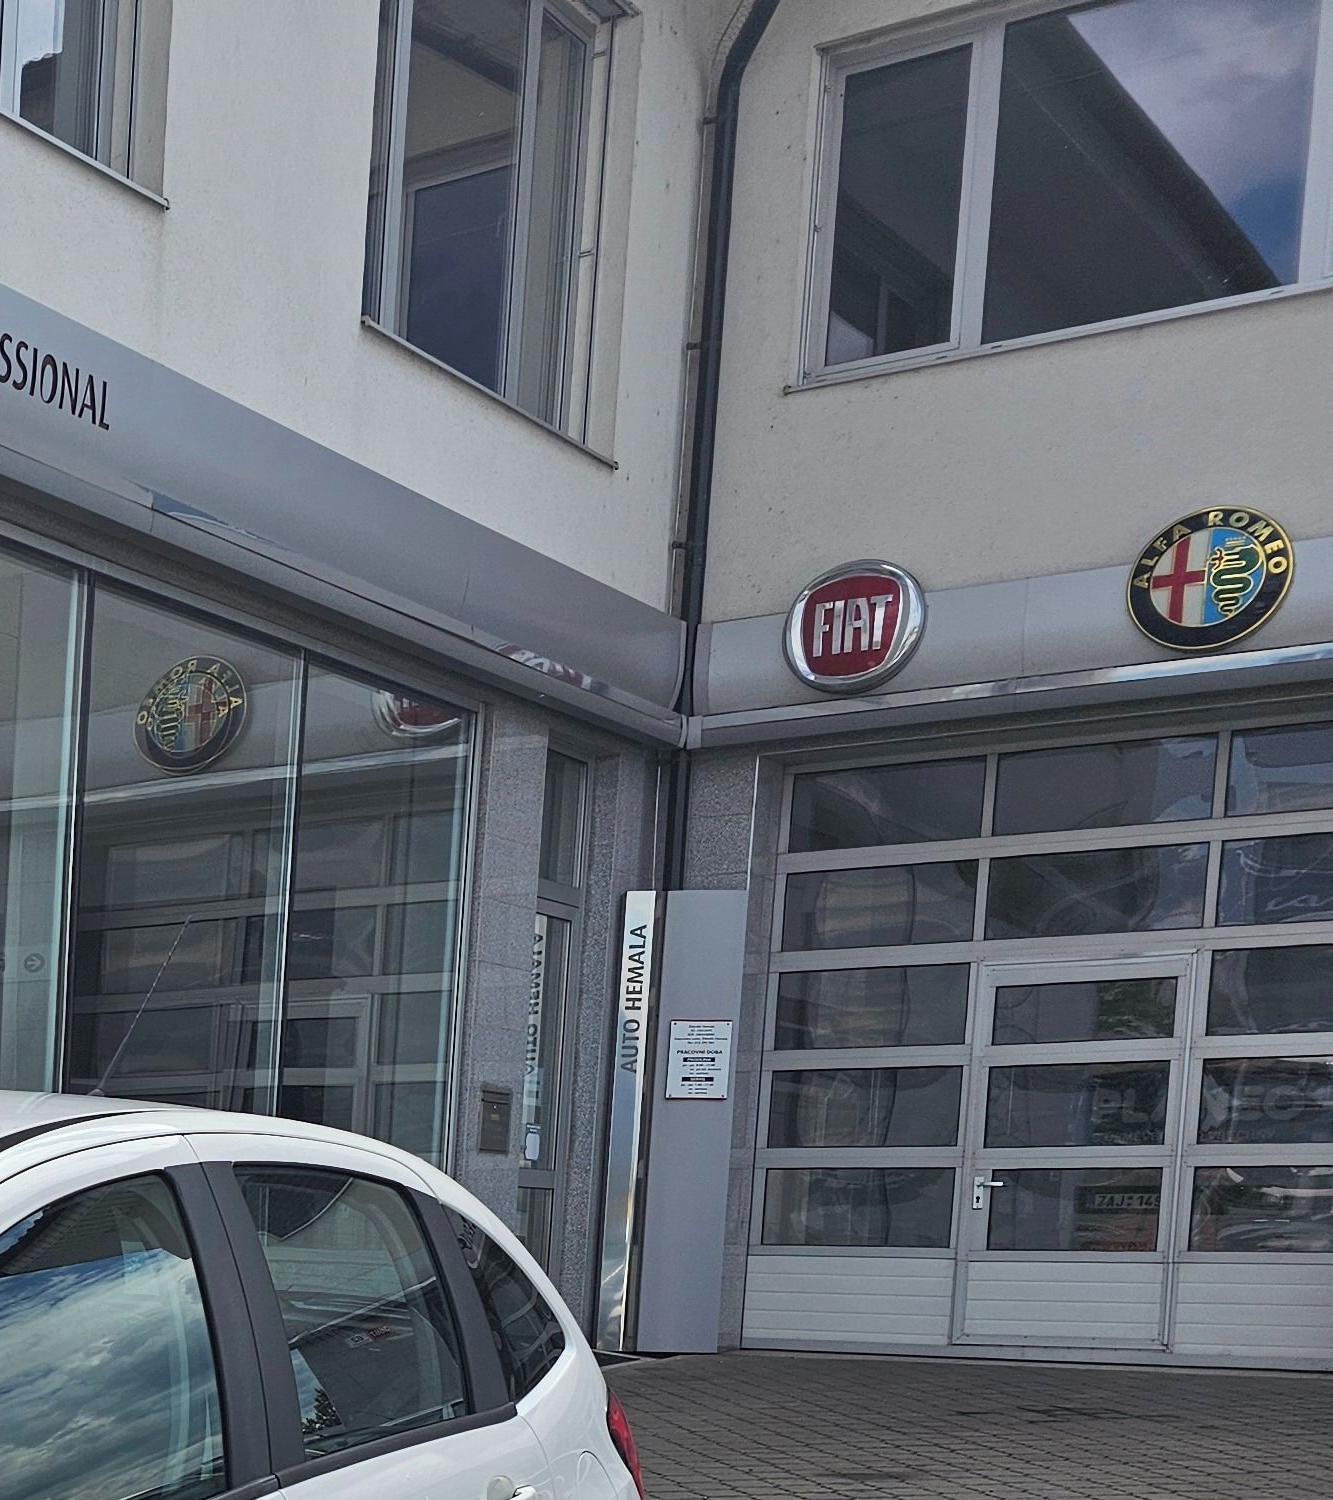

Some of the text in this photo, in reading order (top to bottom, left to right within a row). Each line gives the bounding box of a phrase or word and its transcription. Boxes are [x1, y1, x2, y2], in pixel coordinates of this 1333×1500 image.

[1133, 511, 1288, 589] ALFA ROMEO
[813, 594, 893, 657] FIAT
[620, 924, 647, 1074] AUTO HEMALA
